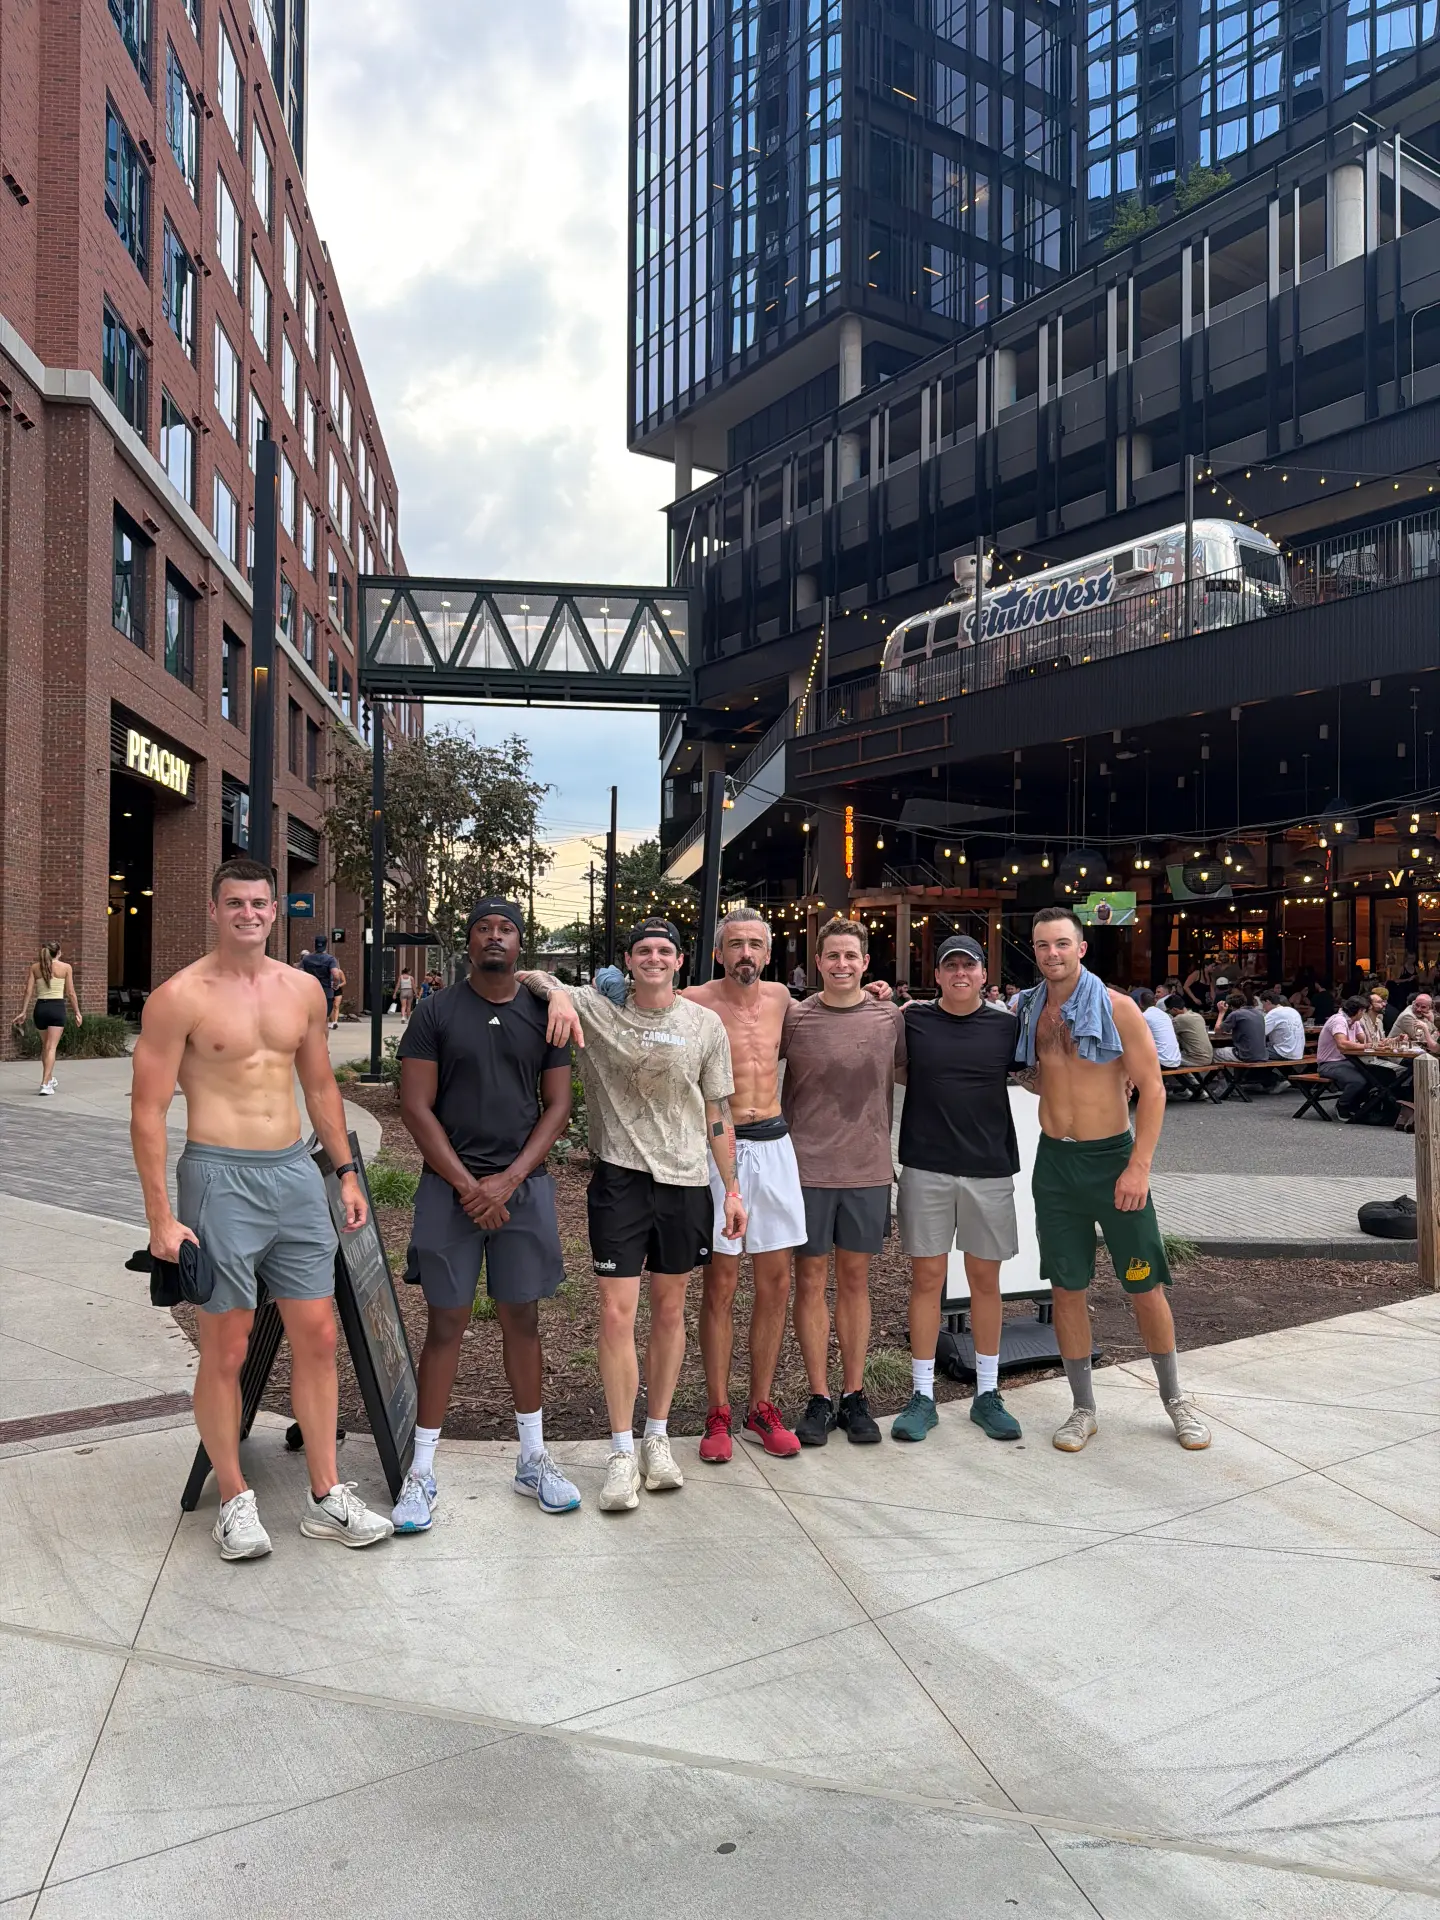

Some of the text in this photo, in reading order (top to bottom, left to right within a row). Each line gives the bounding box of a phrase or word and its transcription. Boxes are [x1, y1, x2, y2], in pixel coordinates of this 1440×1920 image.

[126, 729, 190, 795] PEACHY
[335, 933, 342, 941] P
[642, 1030, 687, 1046] CAROLINA
[600, 1259, 617, 1270] sole
